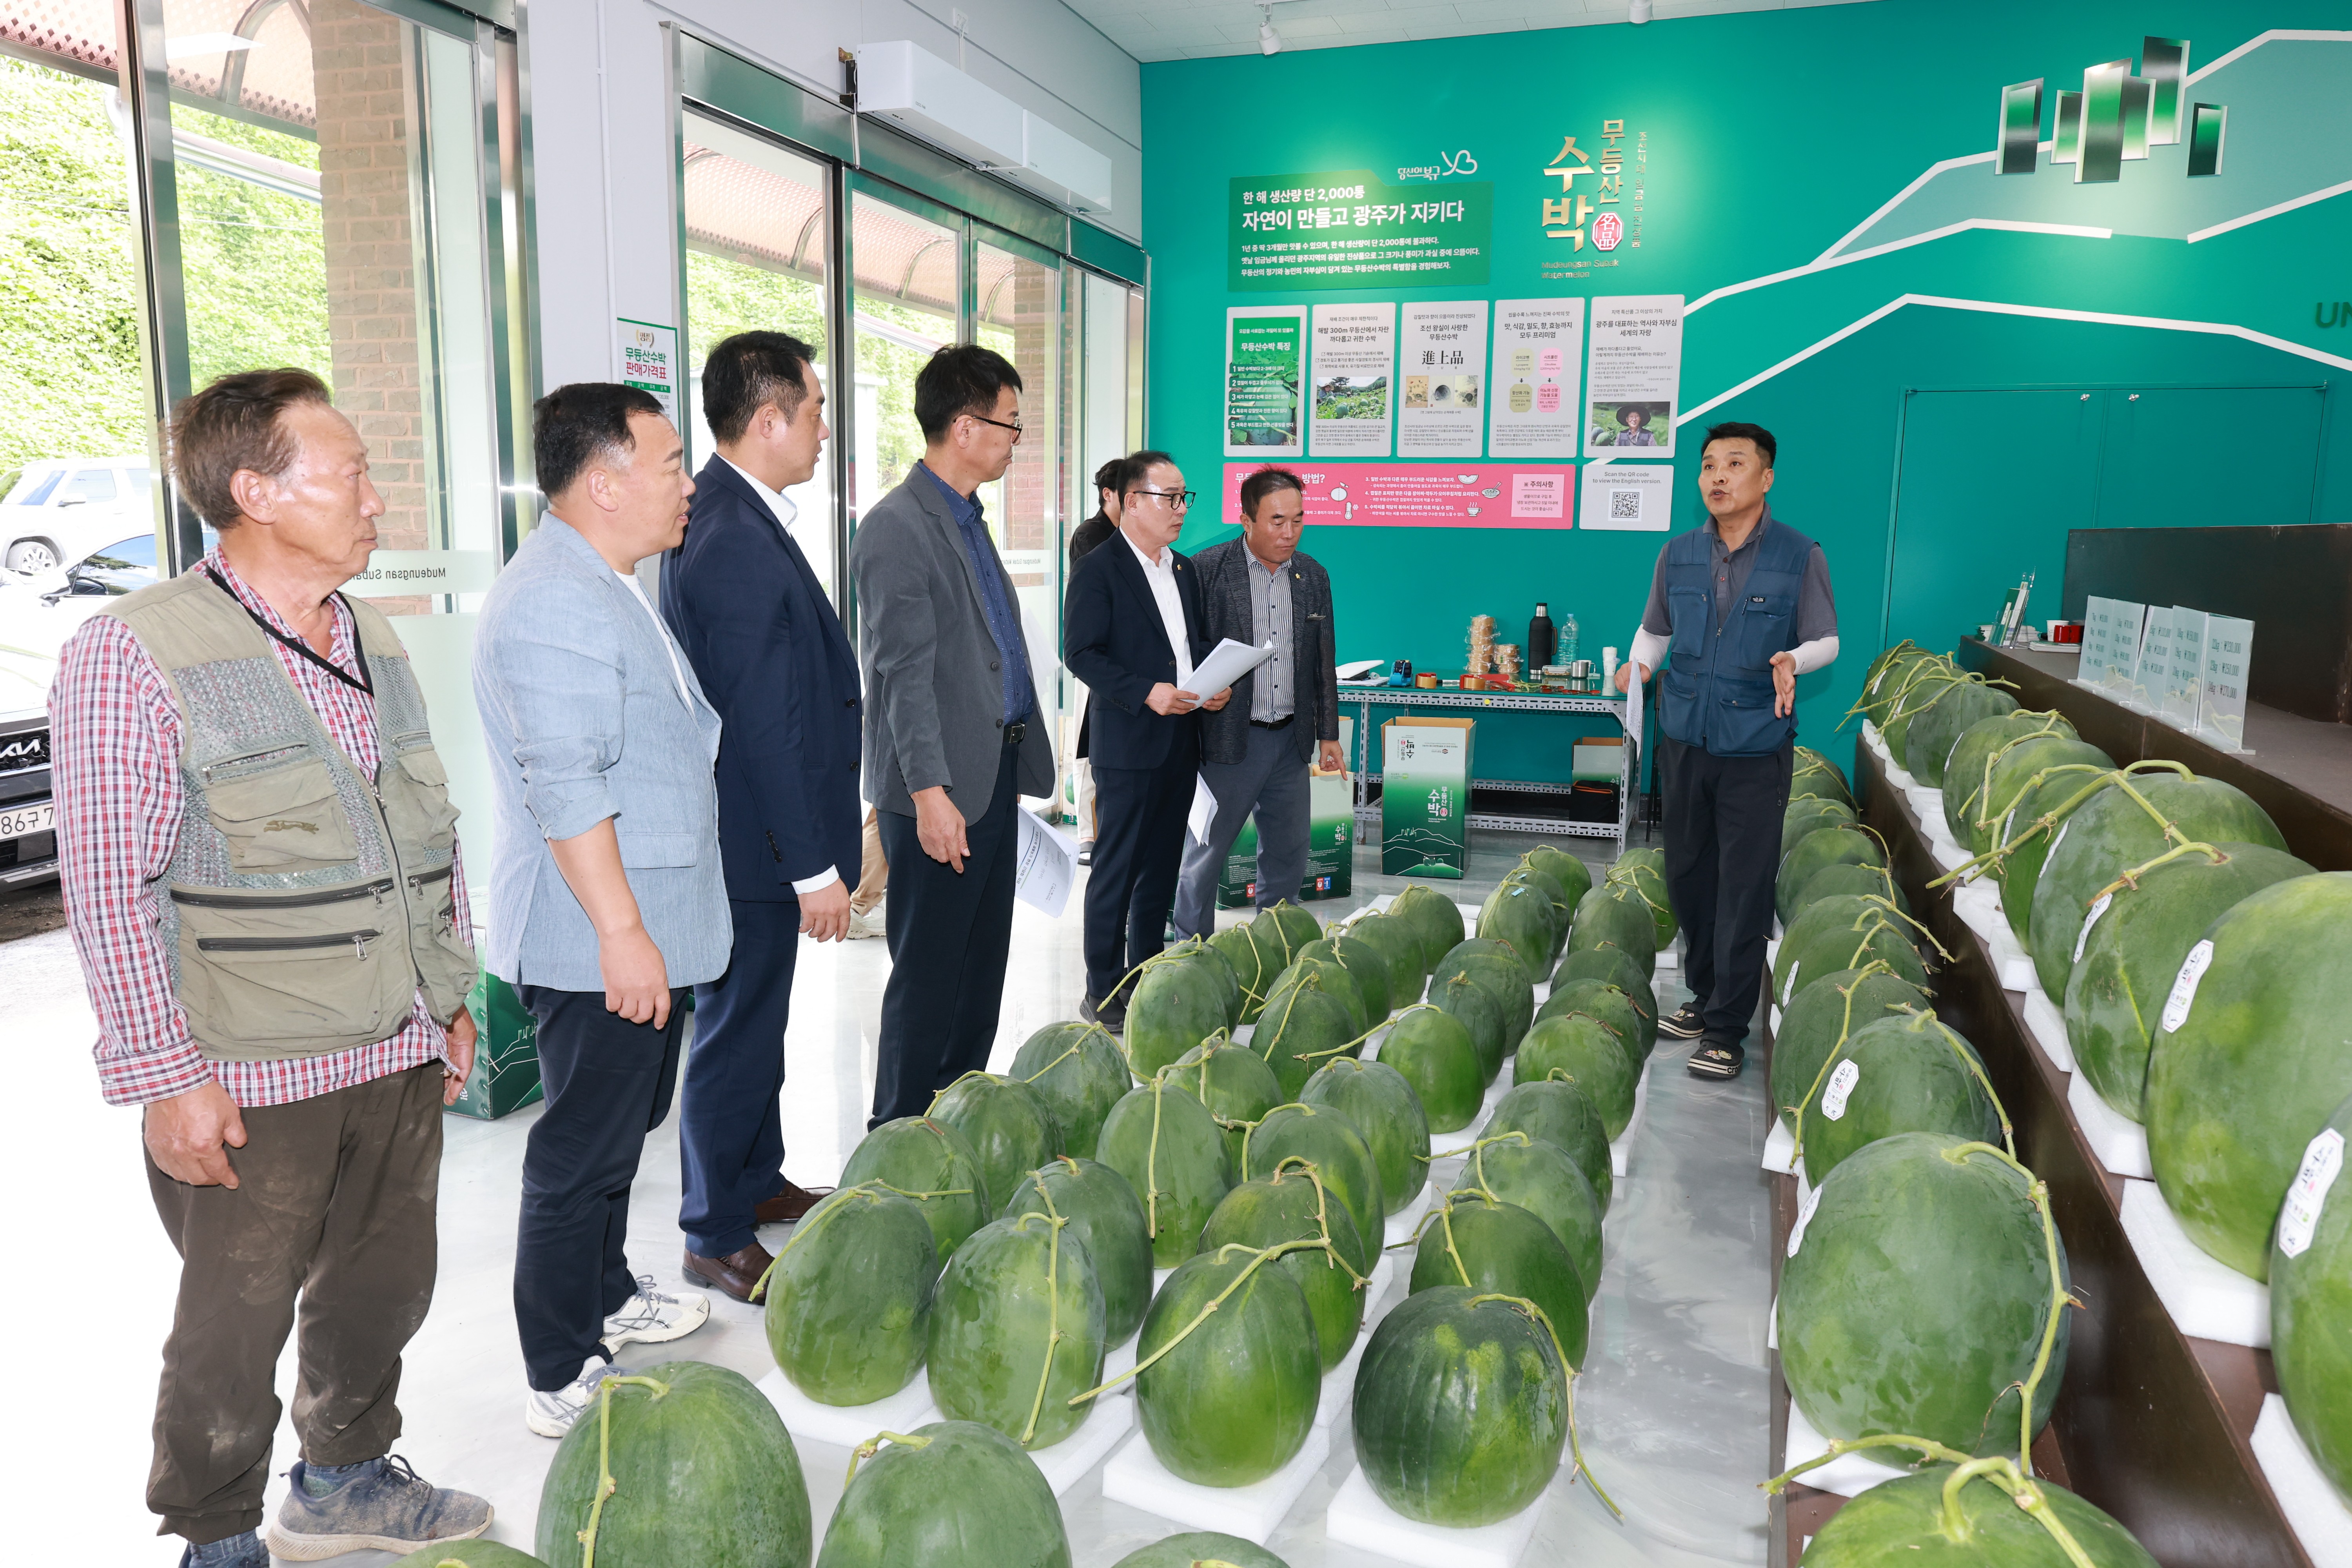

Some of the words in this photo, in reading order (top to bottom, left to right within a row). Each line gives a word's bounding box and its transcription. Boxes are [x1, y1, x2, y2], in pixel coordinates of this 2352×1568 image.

[1599, 120, 1625, 204] 무등산
[1636, 132, 1647, 174] 조선시대
[1243, 191, 1254, 205] 한
[1256, 191, 1267, 204] 해
[1269, 189, 1301, 203] 생산량
[1304, 188, 1314, 201] 단
[1318, 185, 1365, 201] 2,000통
[1542, 136, 1595, 252] 수박
[1634, 179, 1644, 211] 임금님
[1242, 209, 1291, 232] 자연이
[1298, 207, 1348, 229] 만들고
[1353, 203, 1406, 226] 광주가
[1411, 200, 1465, 223] 지키다
[1599, 214, 1616, 247] 名品
[1632, 216, 1642, 248] 진상품
[1266, 243, 1288, 251] 3개월만
[1289, 242, 1301, 250] 맛볼
[1310, 241, 1329, 250] 있으며,
[1346, 240, 1370, 248] 생산량이
[1379, 238, 1412, 247] 2,000통에
[1412, 236, 1439, 245] 불과하다.
[1254, 256, 1278, 264] 임금님께
[1278, 255, 1296, 263] 올리던
[1297, 254, 1327, 262] 광주지역의
[1328, 253, 1345, 261] 유일한
[1347, 252, 1377, 260] 진상품으로
[1405, 250, 1424, 258] 풍미가
[1425, 249, 1438, 257] 과실
[1453, 247, 1479, 256] 으뜸이다.
[1542, 260, 1591, 269] Mudeungsan
[1593, 259, 1619, 267] Subak
[1241, 268, 1265, 276] 무등산의
[1284, 267, 1302, 275] 농민의
[1303, 266, 1327, 274] 자부심이
[1328, 265, 1340, 274] 담겨
[1354, 263, 1392, 272] 무등산수박의
[1392, 262, 1417, 271] 특별함을
[1418, 261, 1450, 270] 경험해보자.
[626, 347, 666, 365] 무등산수박
[1241, 342, 1275, 351] 무등산수박
[1276, 342, 1290, 351] 특징
[1422, 350, 1463, 364] 進上品
[626, 362, 666, 379] 판매가격표
[1302, 474, 1325, 484] 방법?
[1406, 740, 1414, 759] 수박
[1428, 789, 1441, 817] 수박
[1335, 825, 1341, 841] 수박
[1835, 1068, 1845, 1088] 수박
